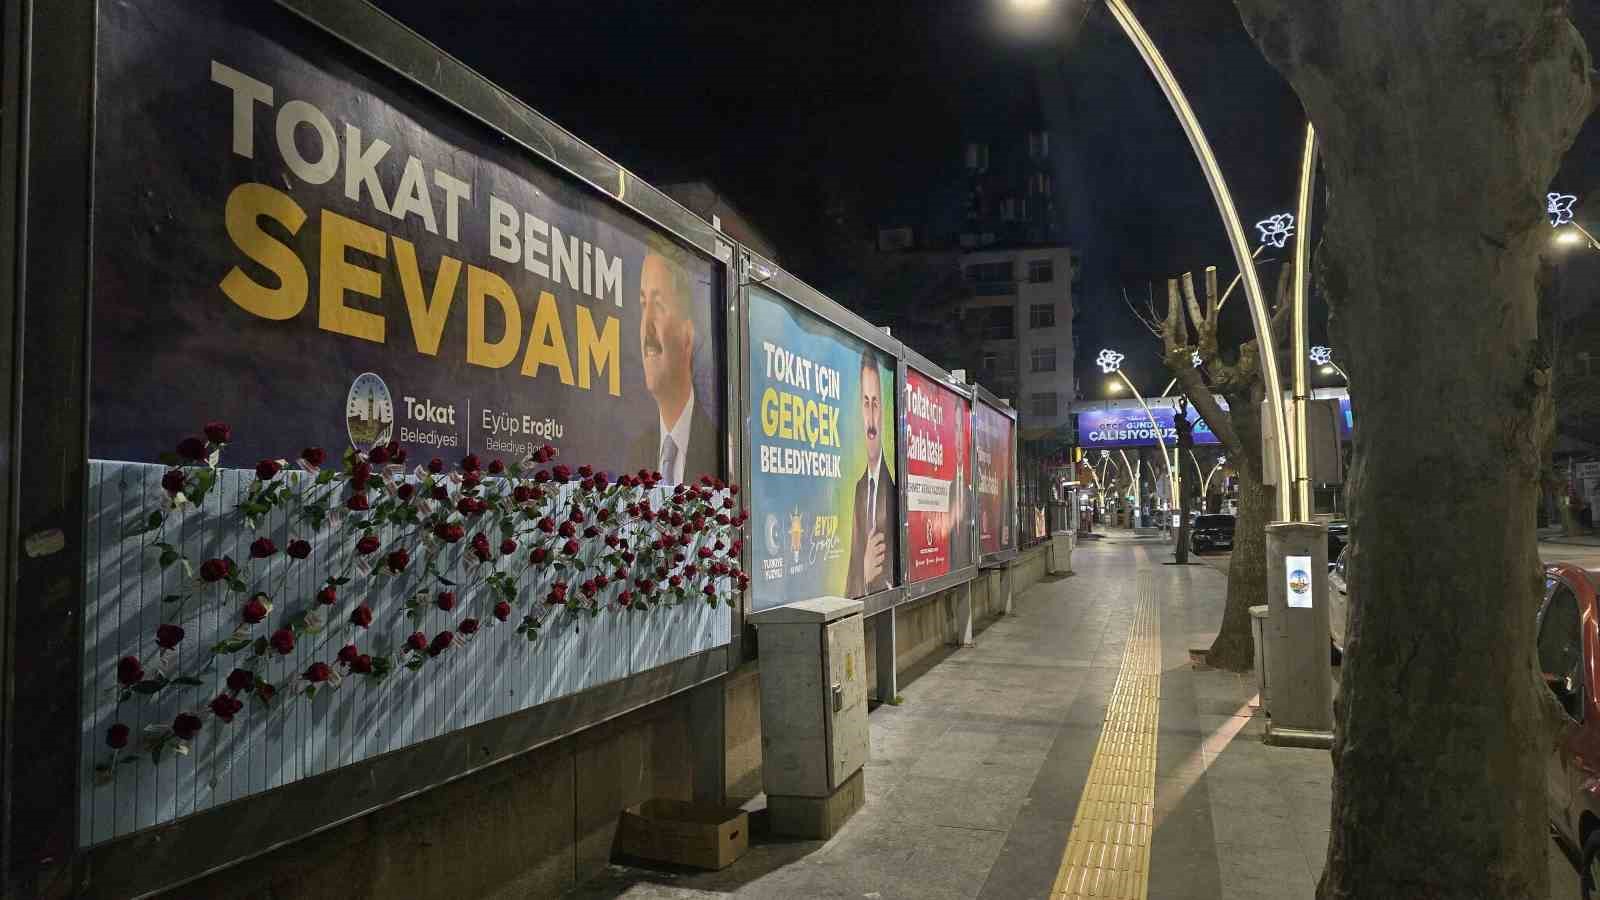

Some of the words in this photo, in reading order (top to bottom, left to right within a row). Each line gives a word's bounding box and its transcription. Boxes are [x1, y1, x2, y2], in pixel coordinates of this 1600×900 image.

[210, 60, 470, 242] TOKAT
[489, 193, 623, 307] BENİM
[218, 181, 621, 397] SEVDAM
[763, 341, 812, 391] TOKAT
[404, 396, 455, 425] Tokat
[761, 387, 841, 449] GERÇEK
[905, 383, 930, 420] Tokat
[400, 427, 458, 449] Belediyesi
[482, 408, 520, 437] Eyüp
[522, 415, 563, 441] Eroğlu
[486, 437, 526, 456] Belediye
[760, 444, 842, 478] BELEDİYECİLİK
